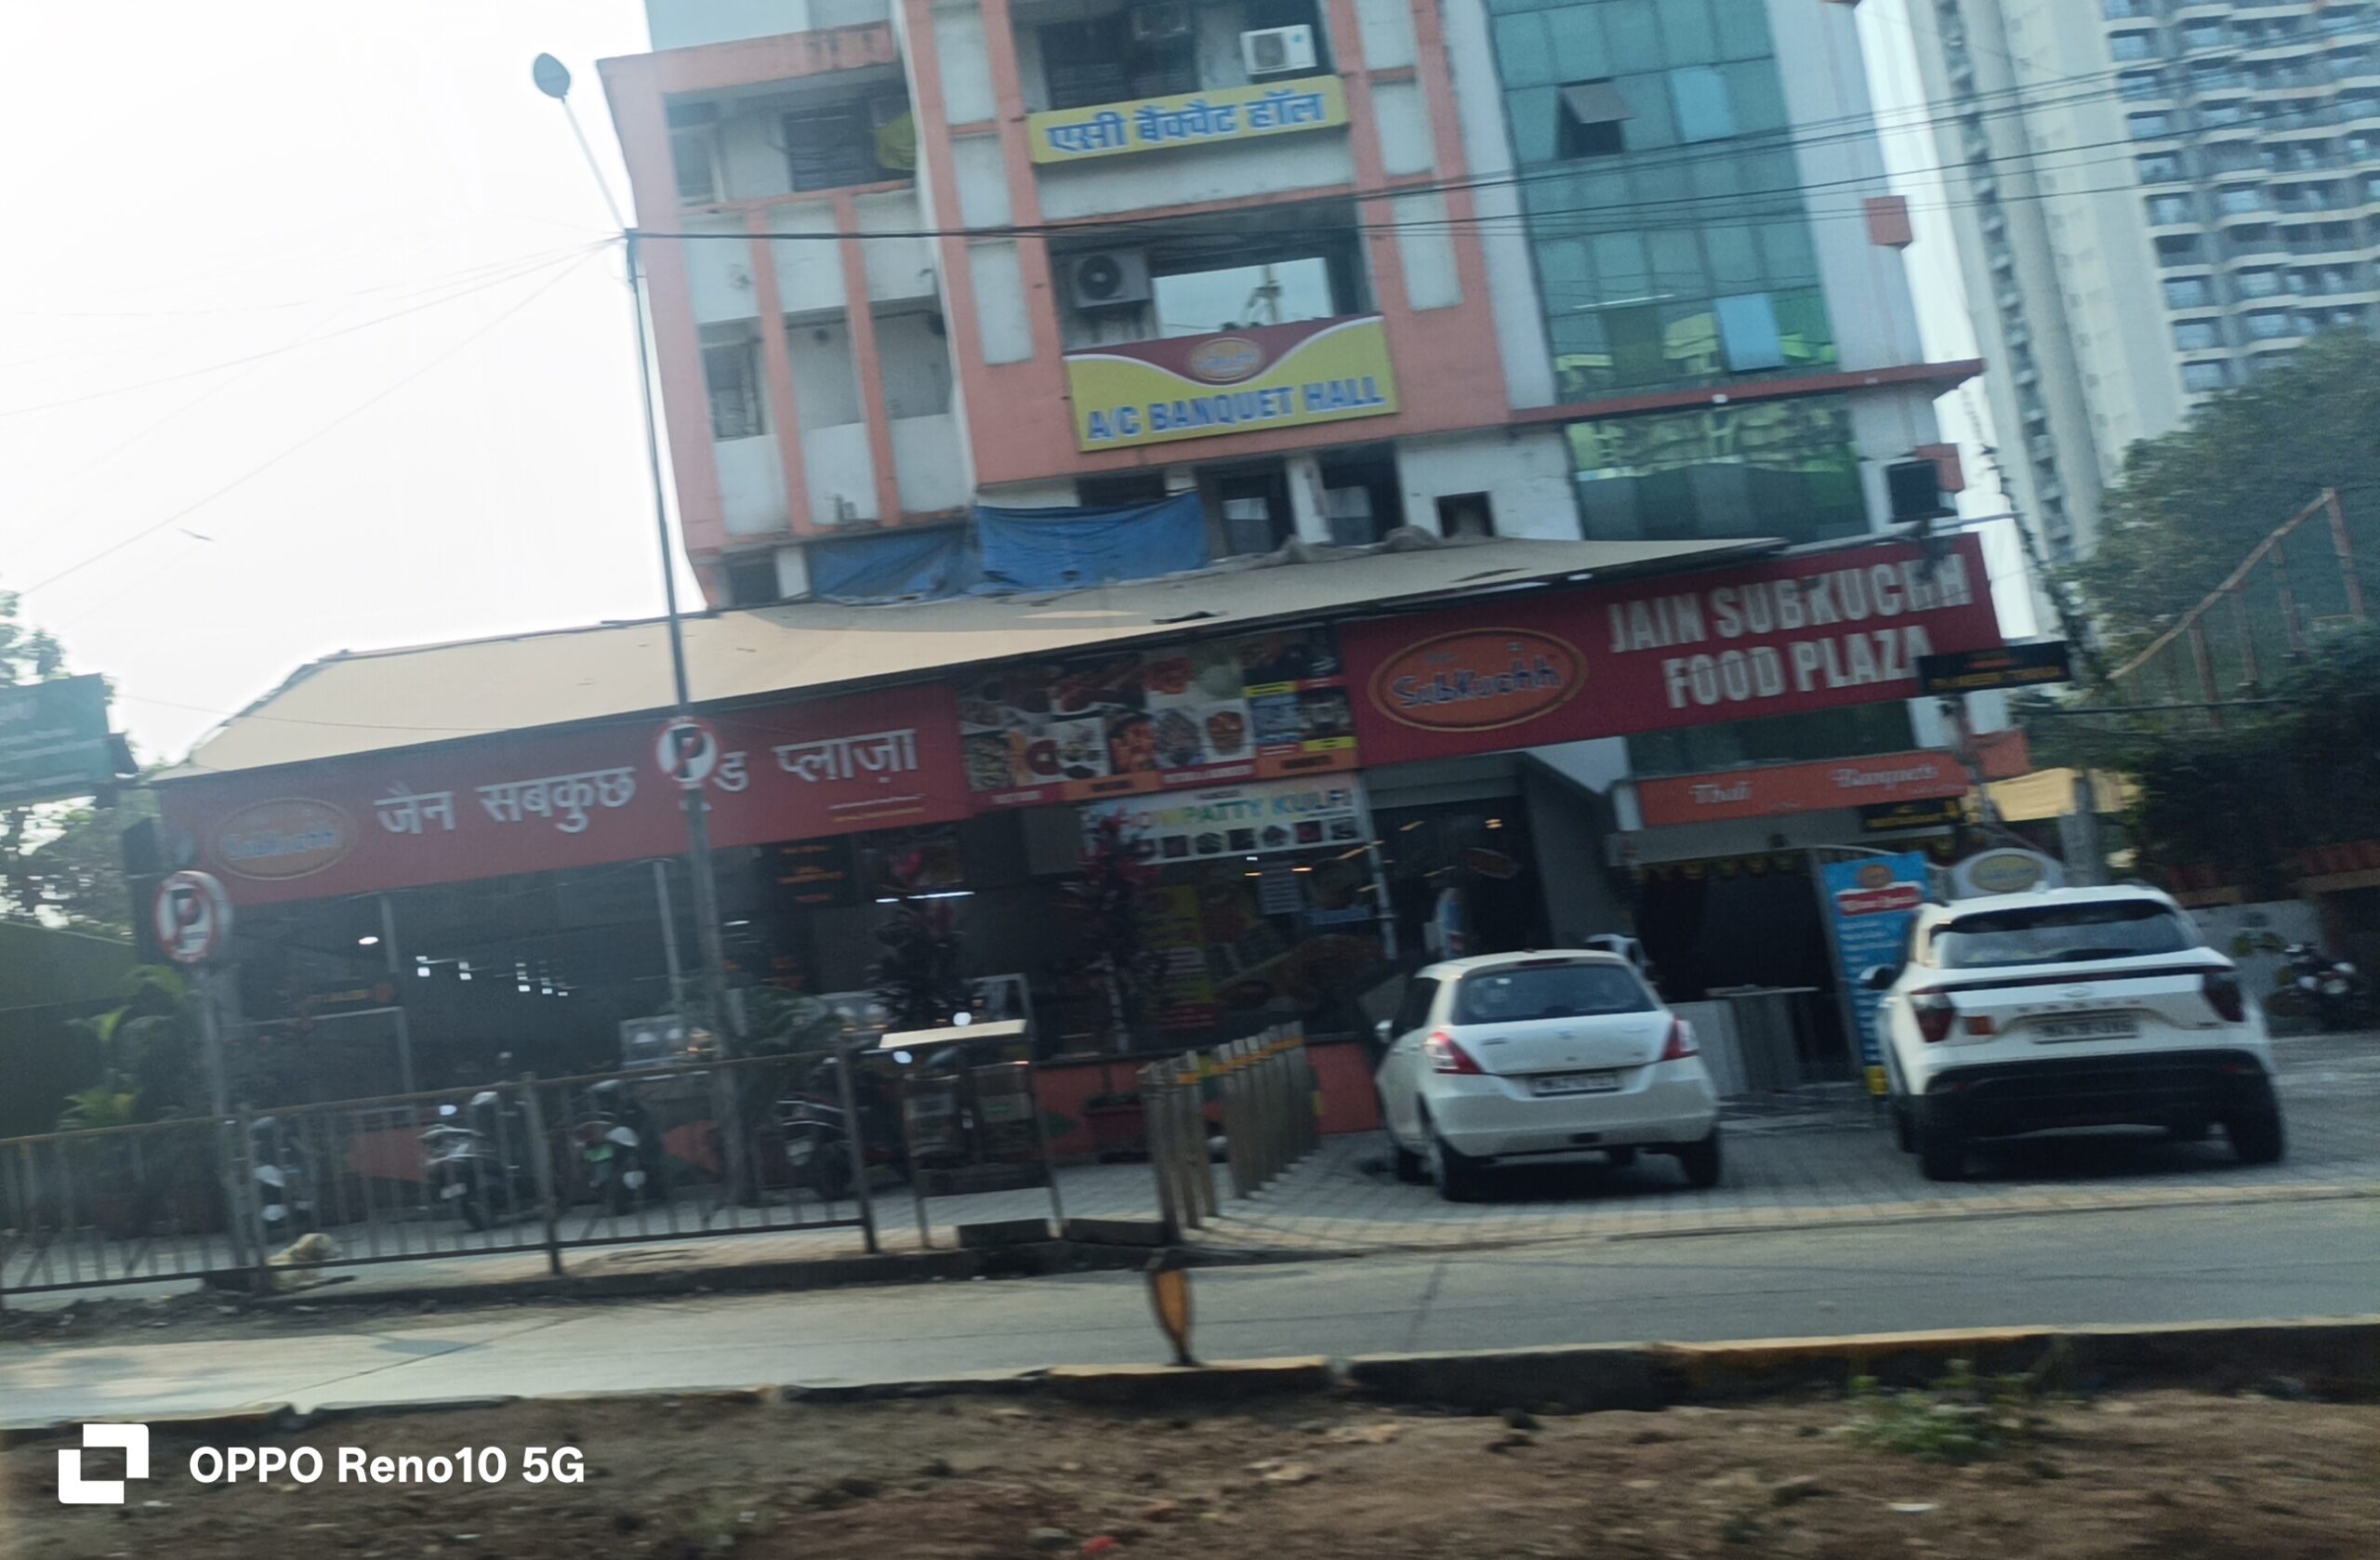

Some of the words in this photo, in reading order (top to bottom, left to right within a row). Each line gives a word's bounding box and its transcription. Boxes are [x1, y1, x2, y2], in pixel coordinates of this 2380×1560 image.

[1044, 111, 1129, 152] एसी
[1244, 88, 1328, 129] हॉल
[1087, 403, 1142, 441] A/C
[1147, 387, 1295, 432] BANQUET
[1302, 376, 1385, 412] HALL
[1606, 592, 1709, 653] JAIN
[1710, 553, 1974, 639] SUBKUCHH
[1661, 646, 1786, 708] FOOD
[1789, 624, 1936, 694] PLAZA
[373, 780, 457, 834] जैन
[475, 766, 638, 834] सबकुछ
